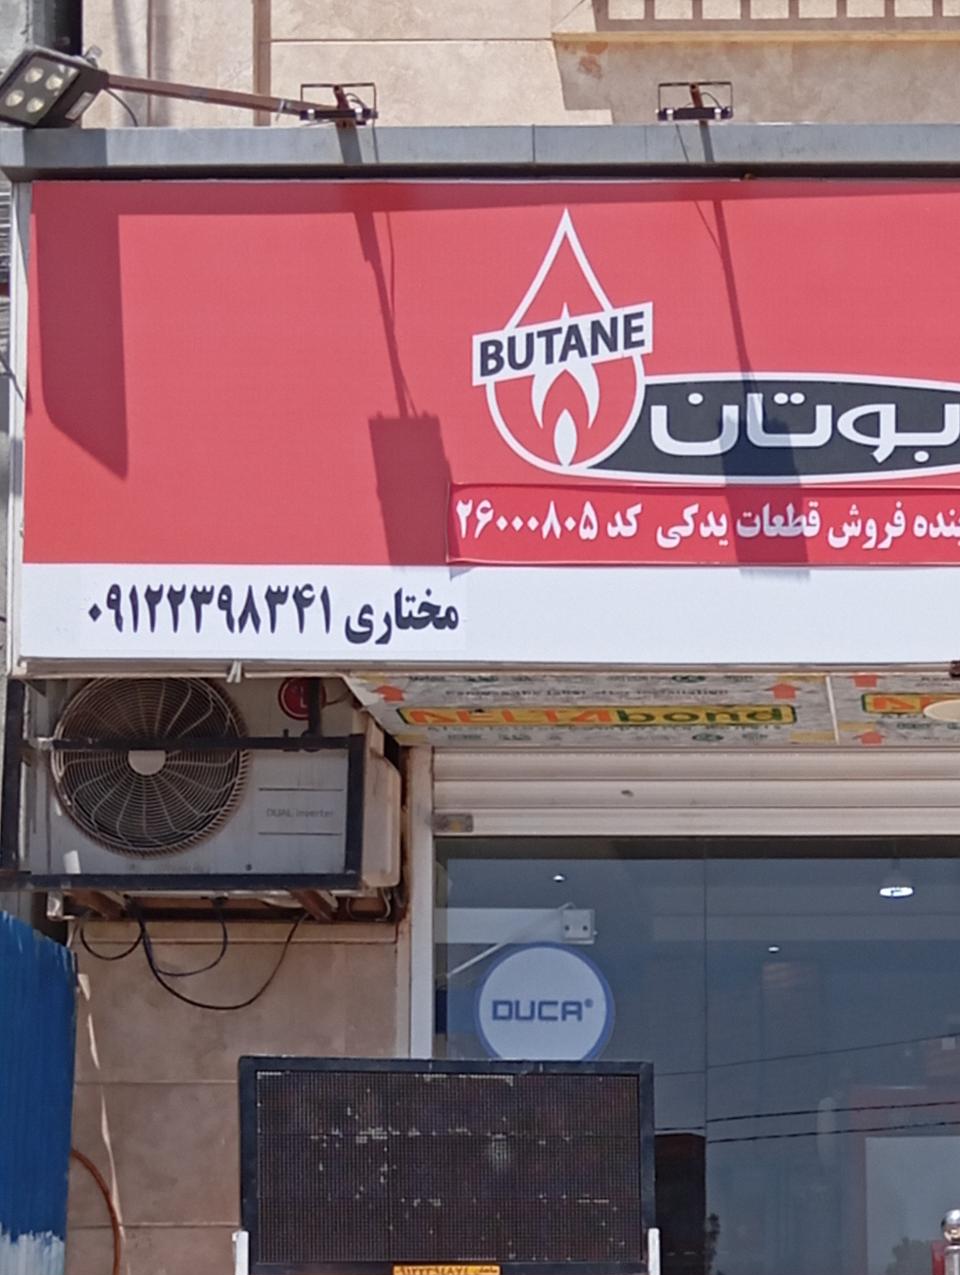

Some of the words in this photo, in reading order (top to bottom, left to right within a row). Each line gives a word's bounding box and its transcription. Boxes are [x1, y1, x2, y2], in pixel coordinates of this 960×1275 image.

[479, 311, 646, 377] BUTANE
[456, 500, 598, 540] ۲۶۰۰۰۸۰۵
[607, 503, 642, 537] کد
[655, 503, 728, 548] یدکی
[735, 501, 821, 540] قطعات
[827, 502, 906, 549] فروش
[88, 583, 331, 634] ۰۹۱۲۲۳۹۸۳۴۱
[344, 588, 459, 645] مختاری
